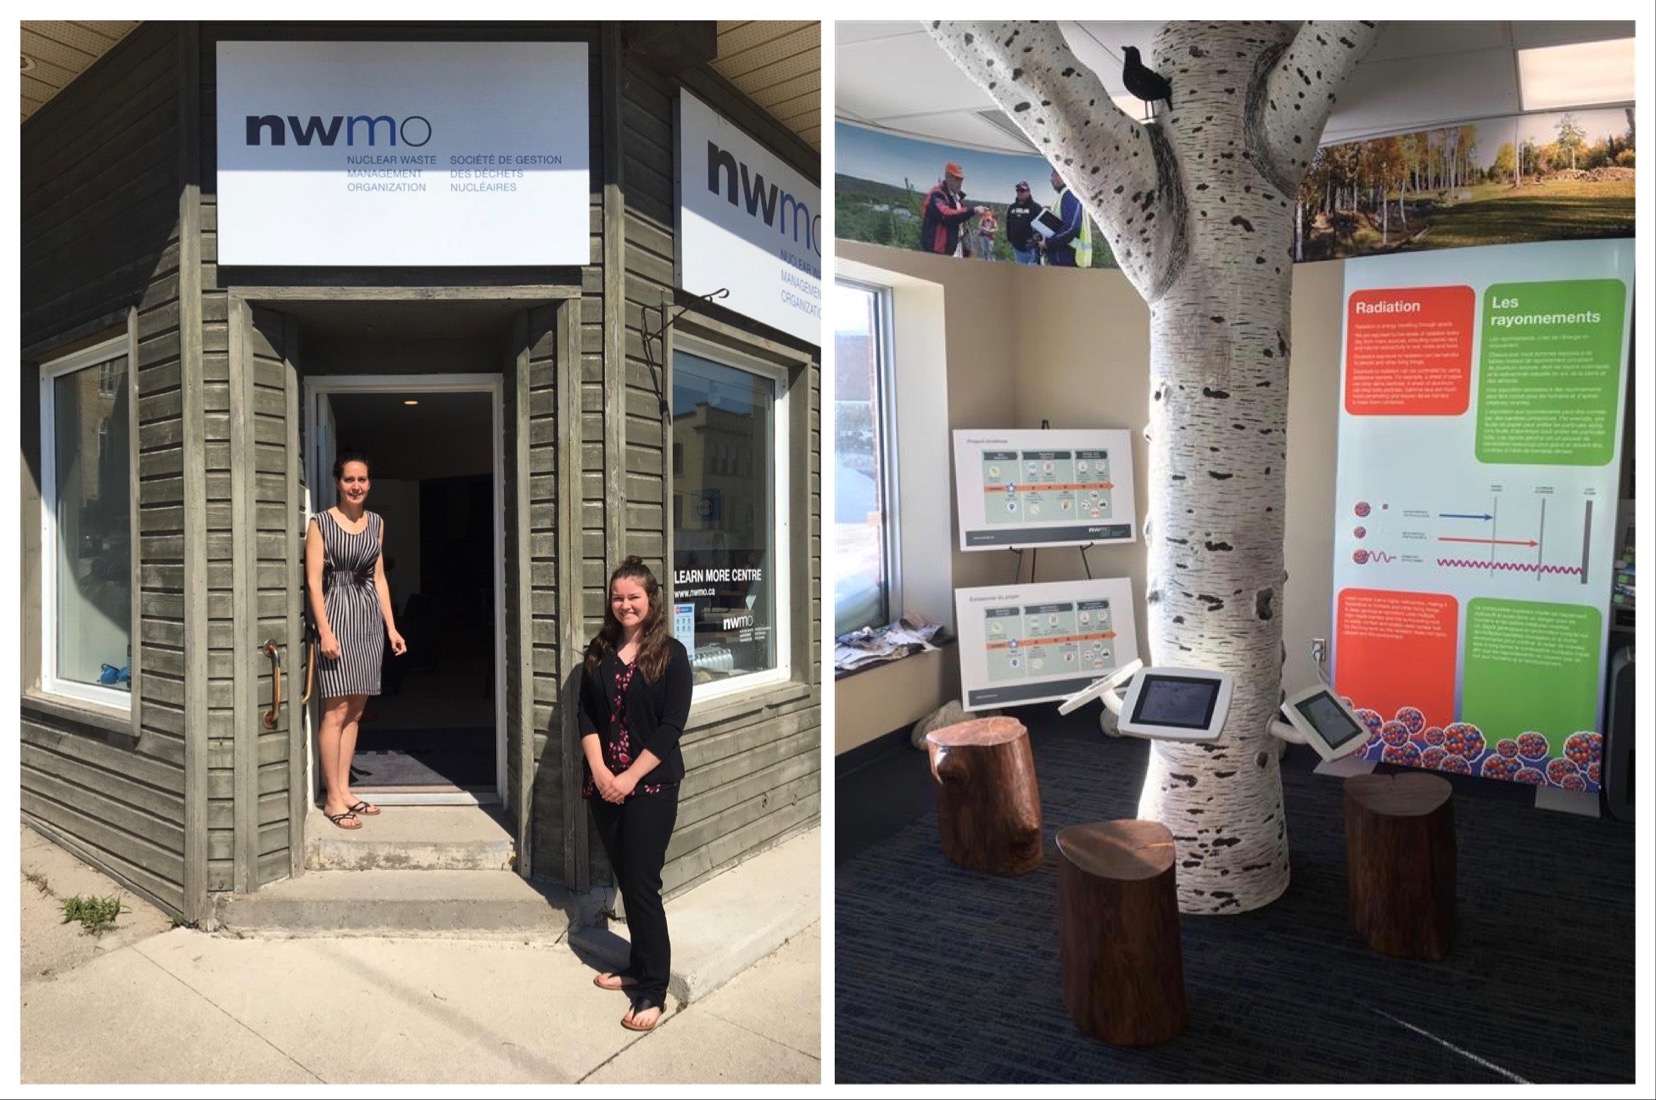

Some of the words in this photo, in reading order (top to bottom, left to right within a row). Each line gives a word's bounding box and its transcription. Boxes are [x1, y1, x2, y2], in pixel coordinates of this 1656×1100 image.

[245, 114, 432, 147] nwmo
[347, 155, 397, 165] NUCLEAR
[400, 155, 437, 165] WASTE
[450, 153, 495, 165] SOCIÉTÉ
[498, 155, 512, 165] DE
[515, 155, 562, 165] GESTION
[347, 169, 423, 178] MANAGEMENT
[450, 169, 472, 178] DES
[474, 167, 524, 178] DÉCHETS
[347, 182, 426, 192] ORGANIZATION
[450, 181, 517, 192] NUCLÉAIRES
[780, 248, 811, 275] NUCLEAR
[1355, 299, 1421, 314] Radiation
[1491, 296, 1519, 309] Les
[1490, 311, 1602, 328] rayonnements
[674, 569, 704, 584] LEARN
[705, 568, 730, 582] MORE
[731, 568, 762, 581] CENTRE
[674, 588, 716, 598] www.nwmo.ca
[723, 615, 754, 631] nwmo
